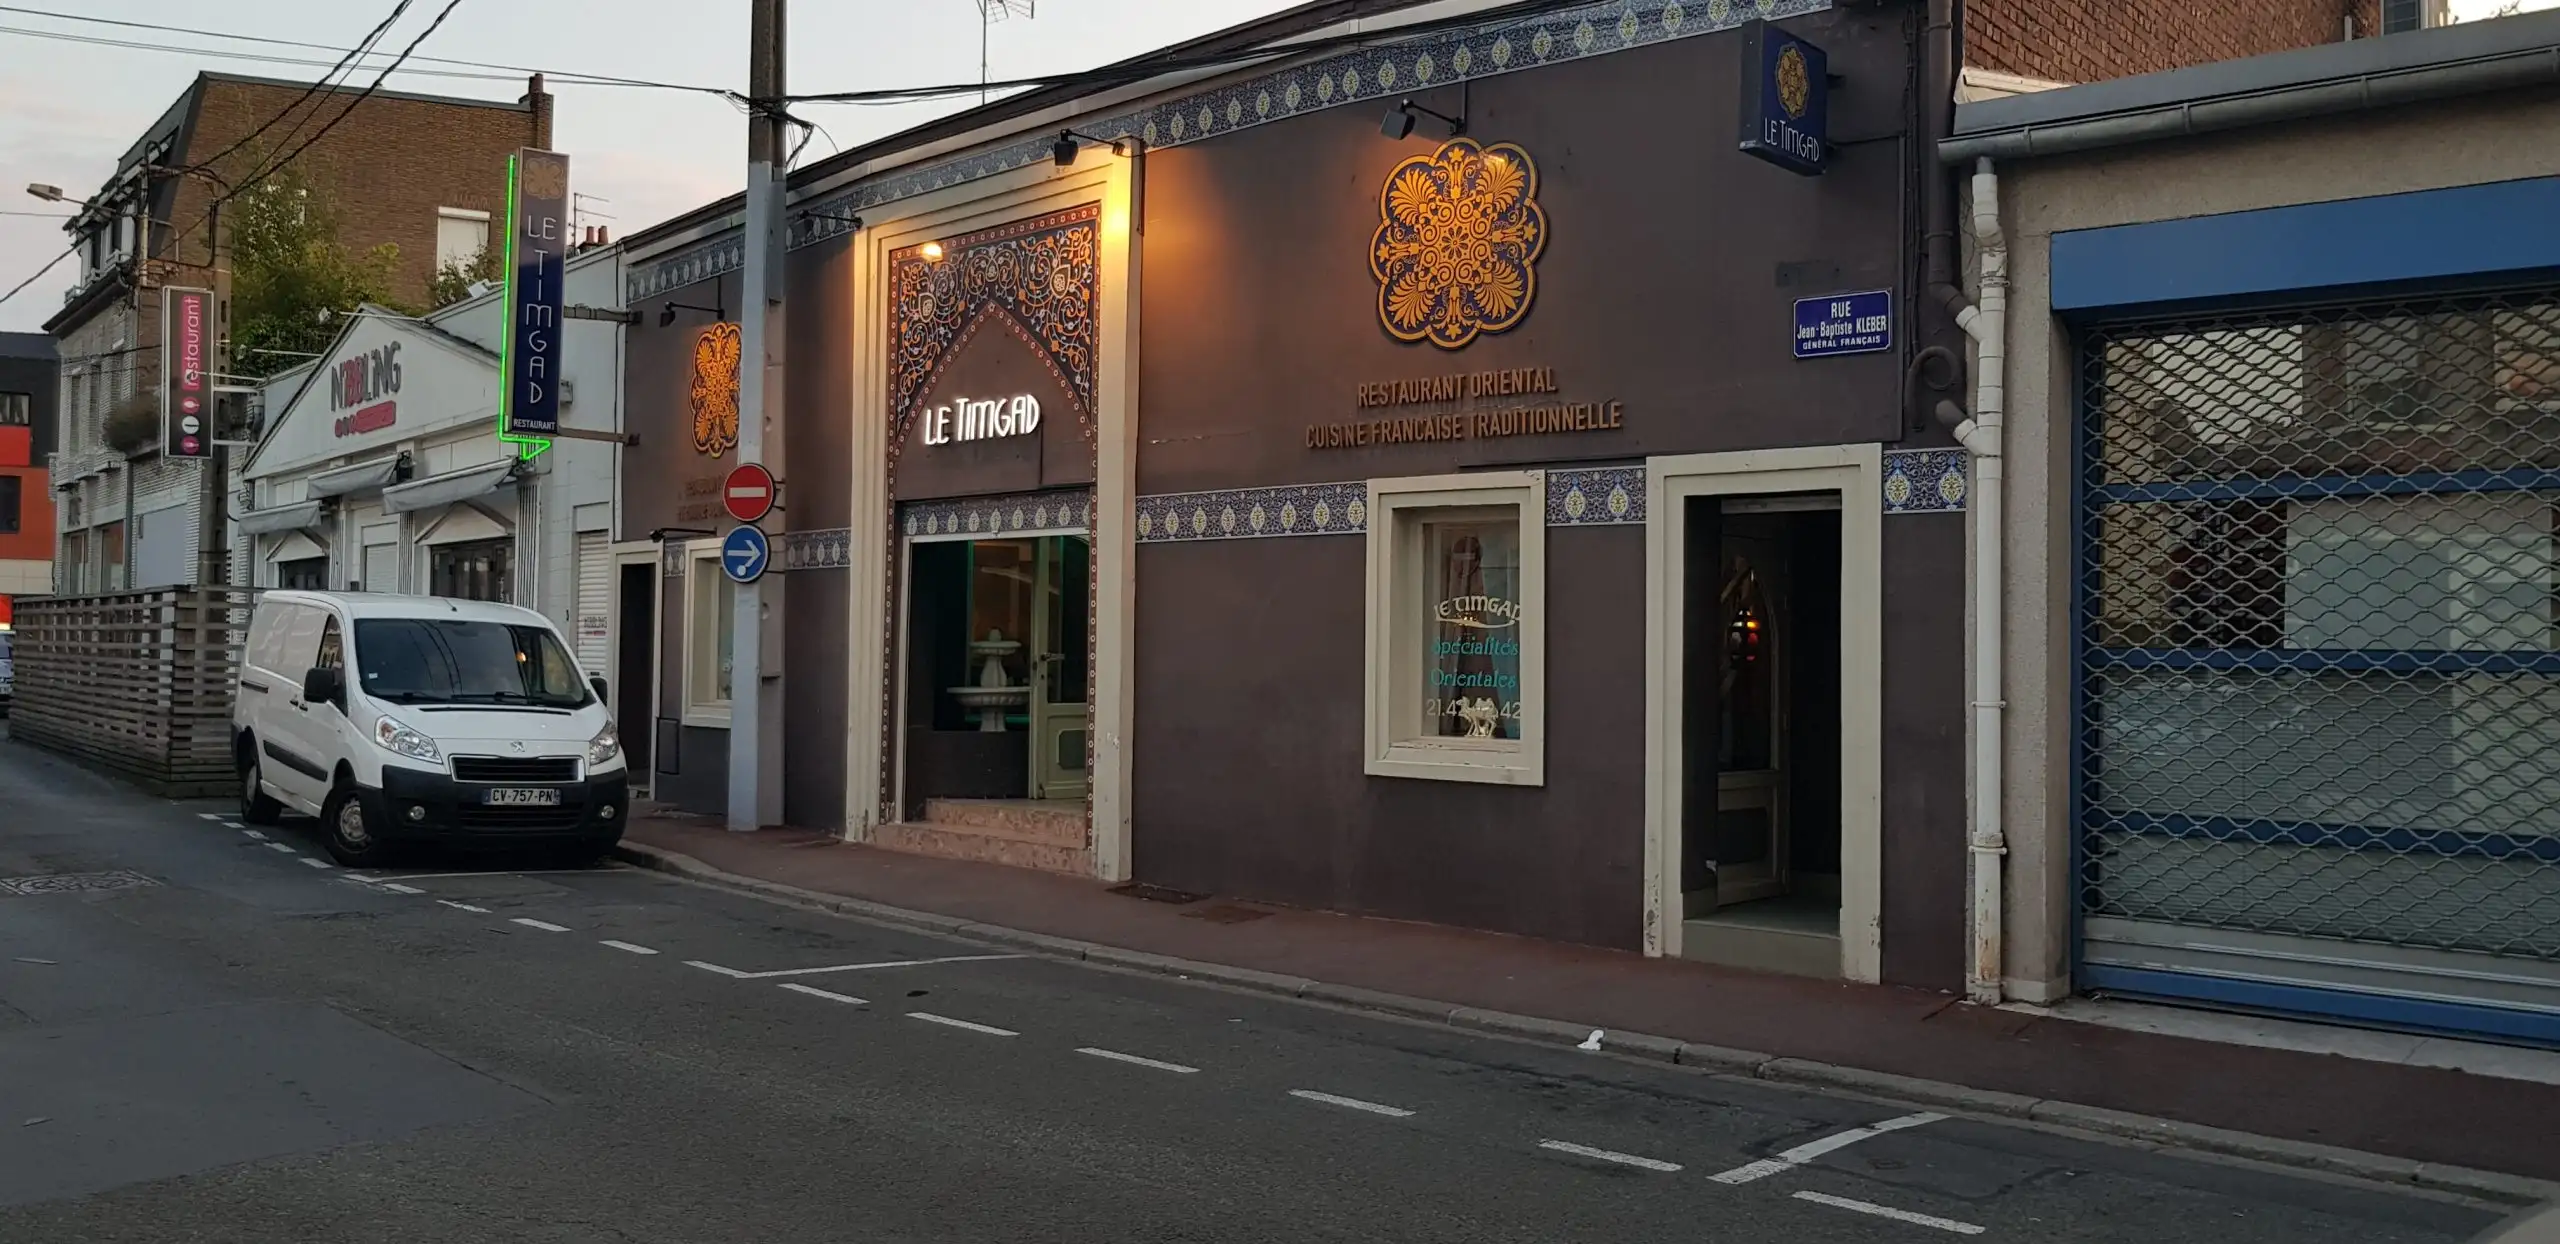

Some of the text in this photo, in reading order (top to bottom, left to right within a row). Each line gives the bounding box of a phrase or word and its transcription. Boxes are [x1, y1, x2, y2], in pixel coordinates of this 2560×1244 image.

[1764, 117, 1820, 162] LE TIMGAD
[528, 215, 557, 240] LE
[1831, 301, 1851, 319] RUE
[526, 249, 552, 404] TIMGAD
[1856, 315, 1887, 334] KLEBER
[184, 297, 200, 387] restaurant
[1840, 335, 1881, 348] FRANÇAIS
[1358, 366, 1557, 407] RESTAURANT ORIENTAL
[513, 418, 556, 431] RESTAURANT
[924, 393, 1041, 445] LE TIMGAD
[1306, 422, 1368, 449] CUISINE
[1470, 401, 1622, 438] TRADITIONNELLE
[1431, 634, 1519, 659] Spécialités
[1431, 669, 1517, 689] Orientales
[492, 789, 553, 803] CV-757-PN
